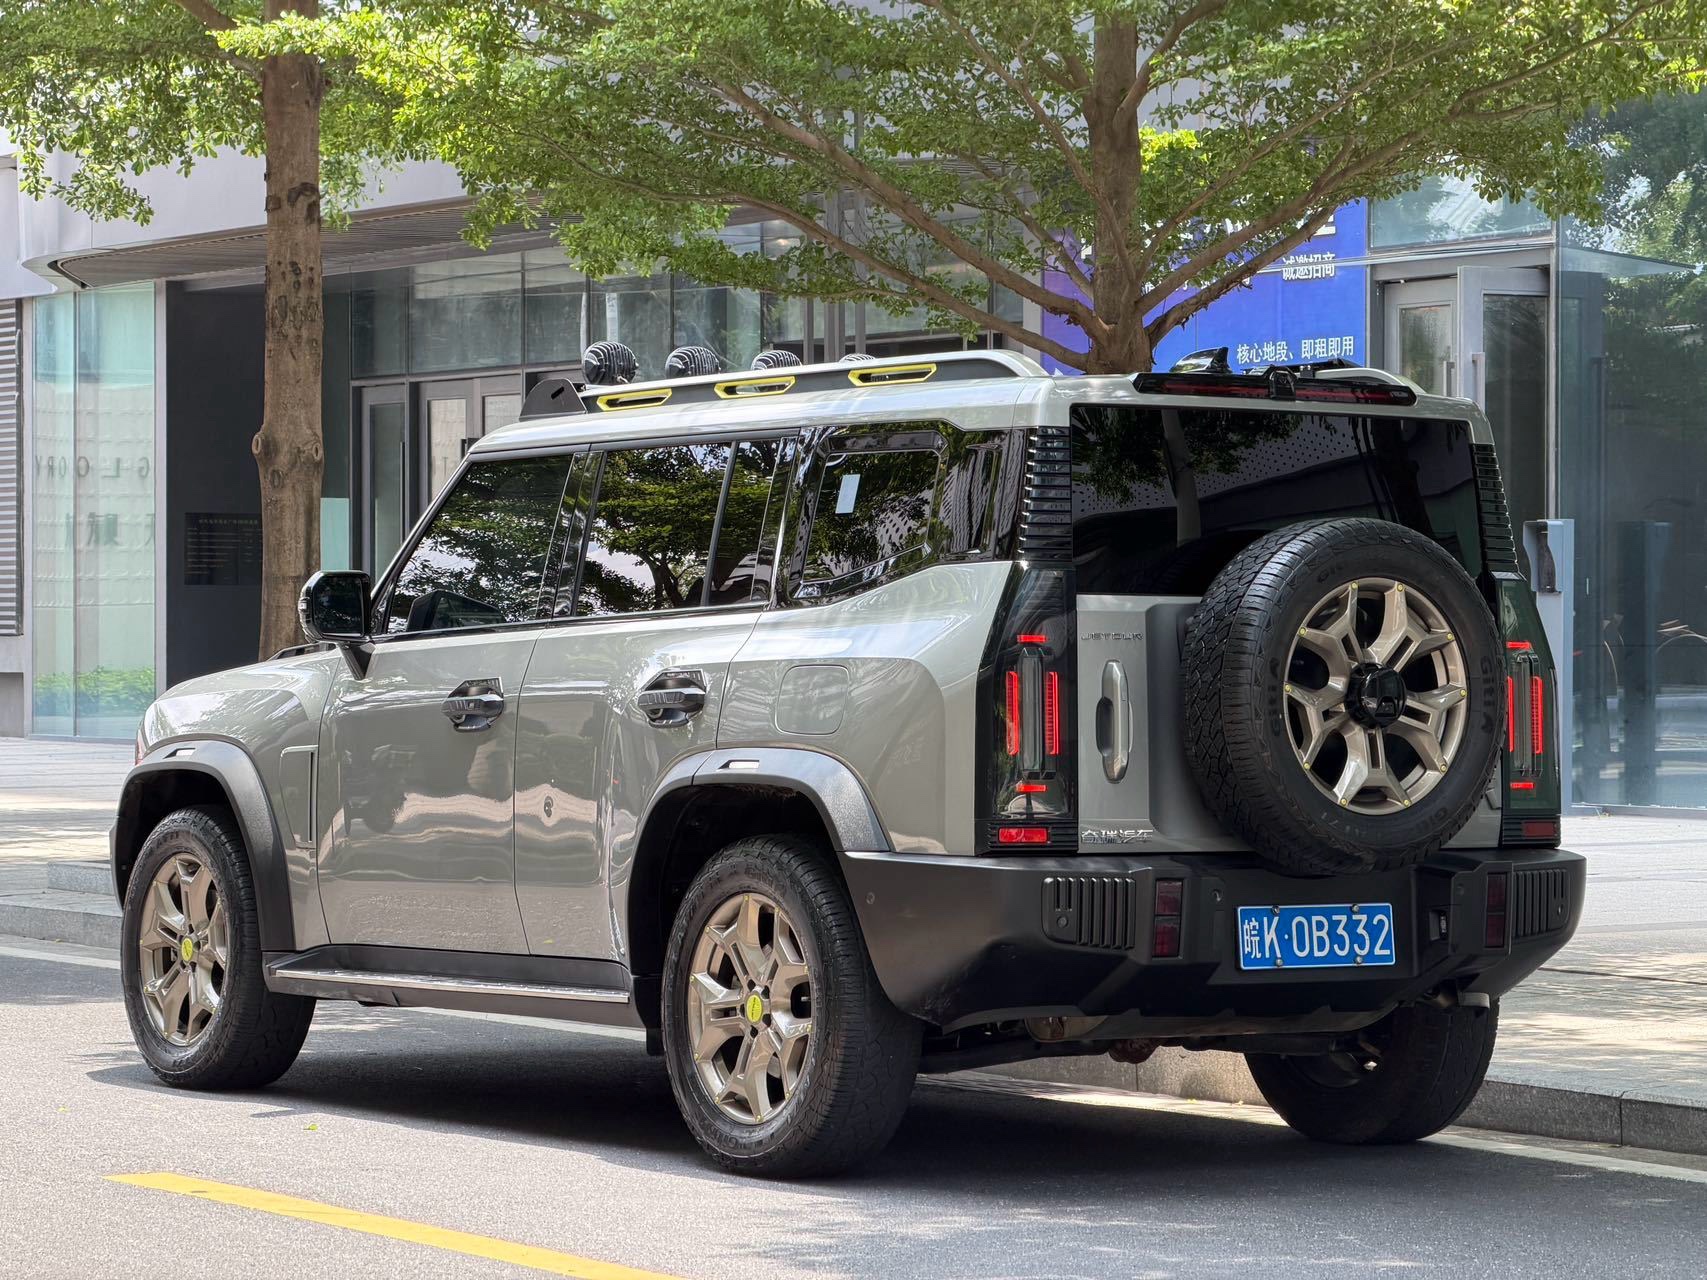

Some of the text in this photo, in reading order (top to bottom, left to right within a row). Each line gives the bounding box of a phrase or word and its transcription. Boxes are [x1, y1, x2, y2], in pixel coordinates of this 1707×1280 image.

[1236, 335, 1354, 364] 核心地段、即租即用
